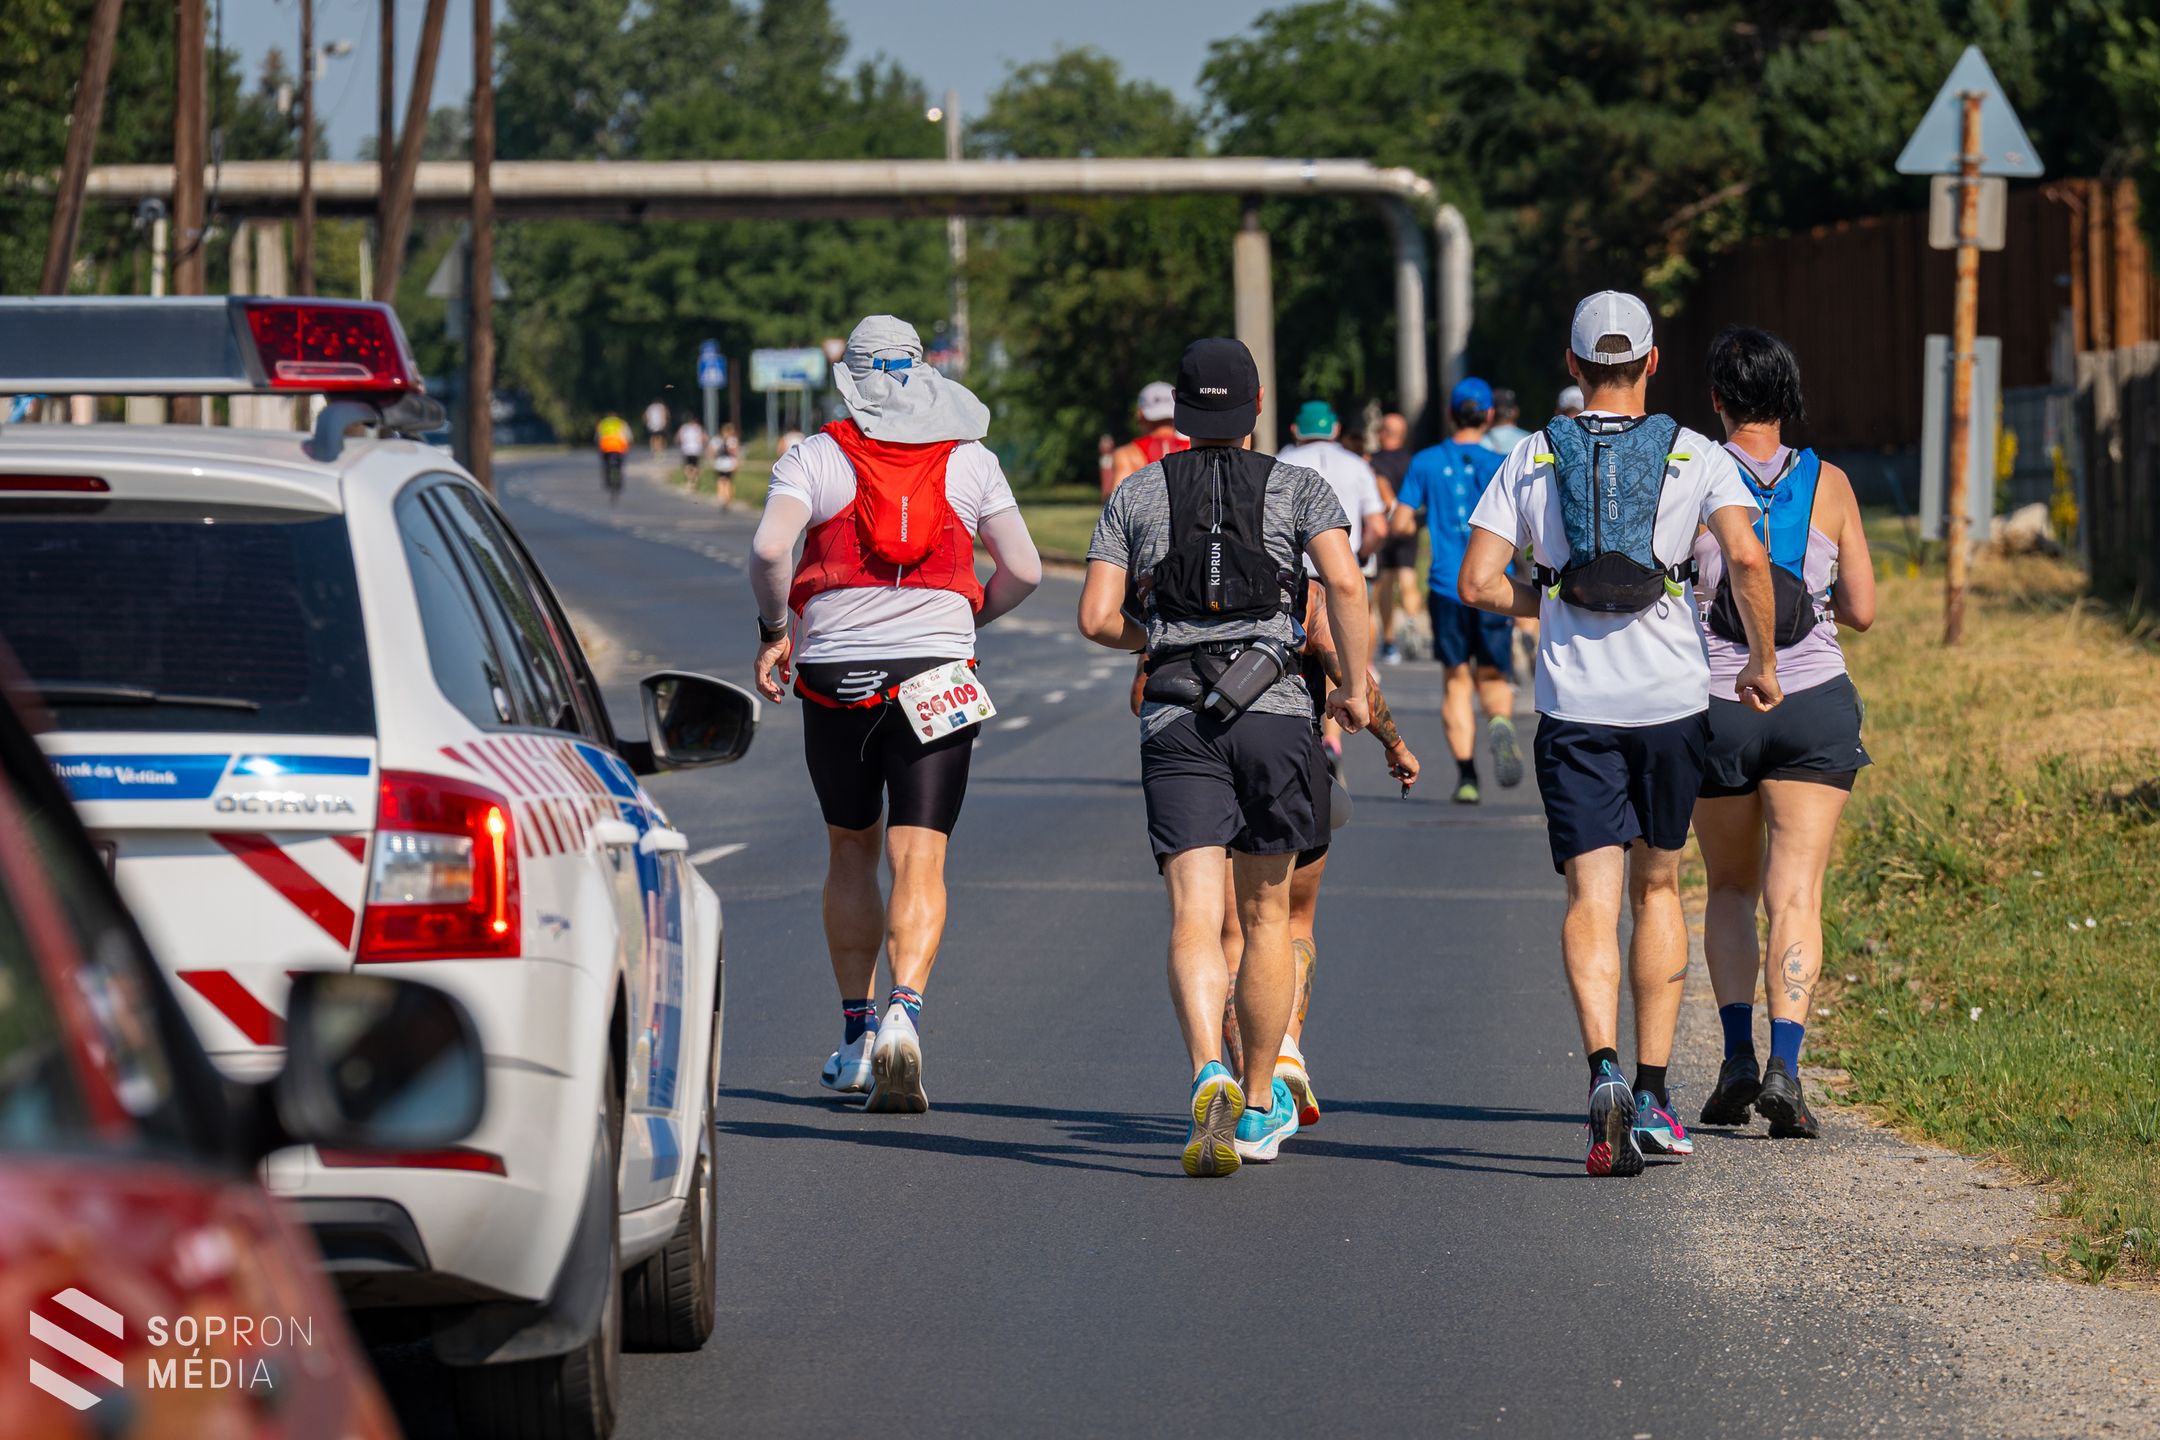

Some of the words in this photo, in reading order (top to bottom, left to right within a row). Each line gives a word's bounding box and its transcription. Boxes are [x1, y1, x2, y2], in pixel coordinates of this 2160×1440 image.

[1200, 387, 1228, 395] KIPRUN
[901, 495, 909, 543] SALOMON
[1210, 542, 1221, 586] KIPRUN
